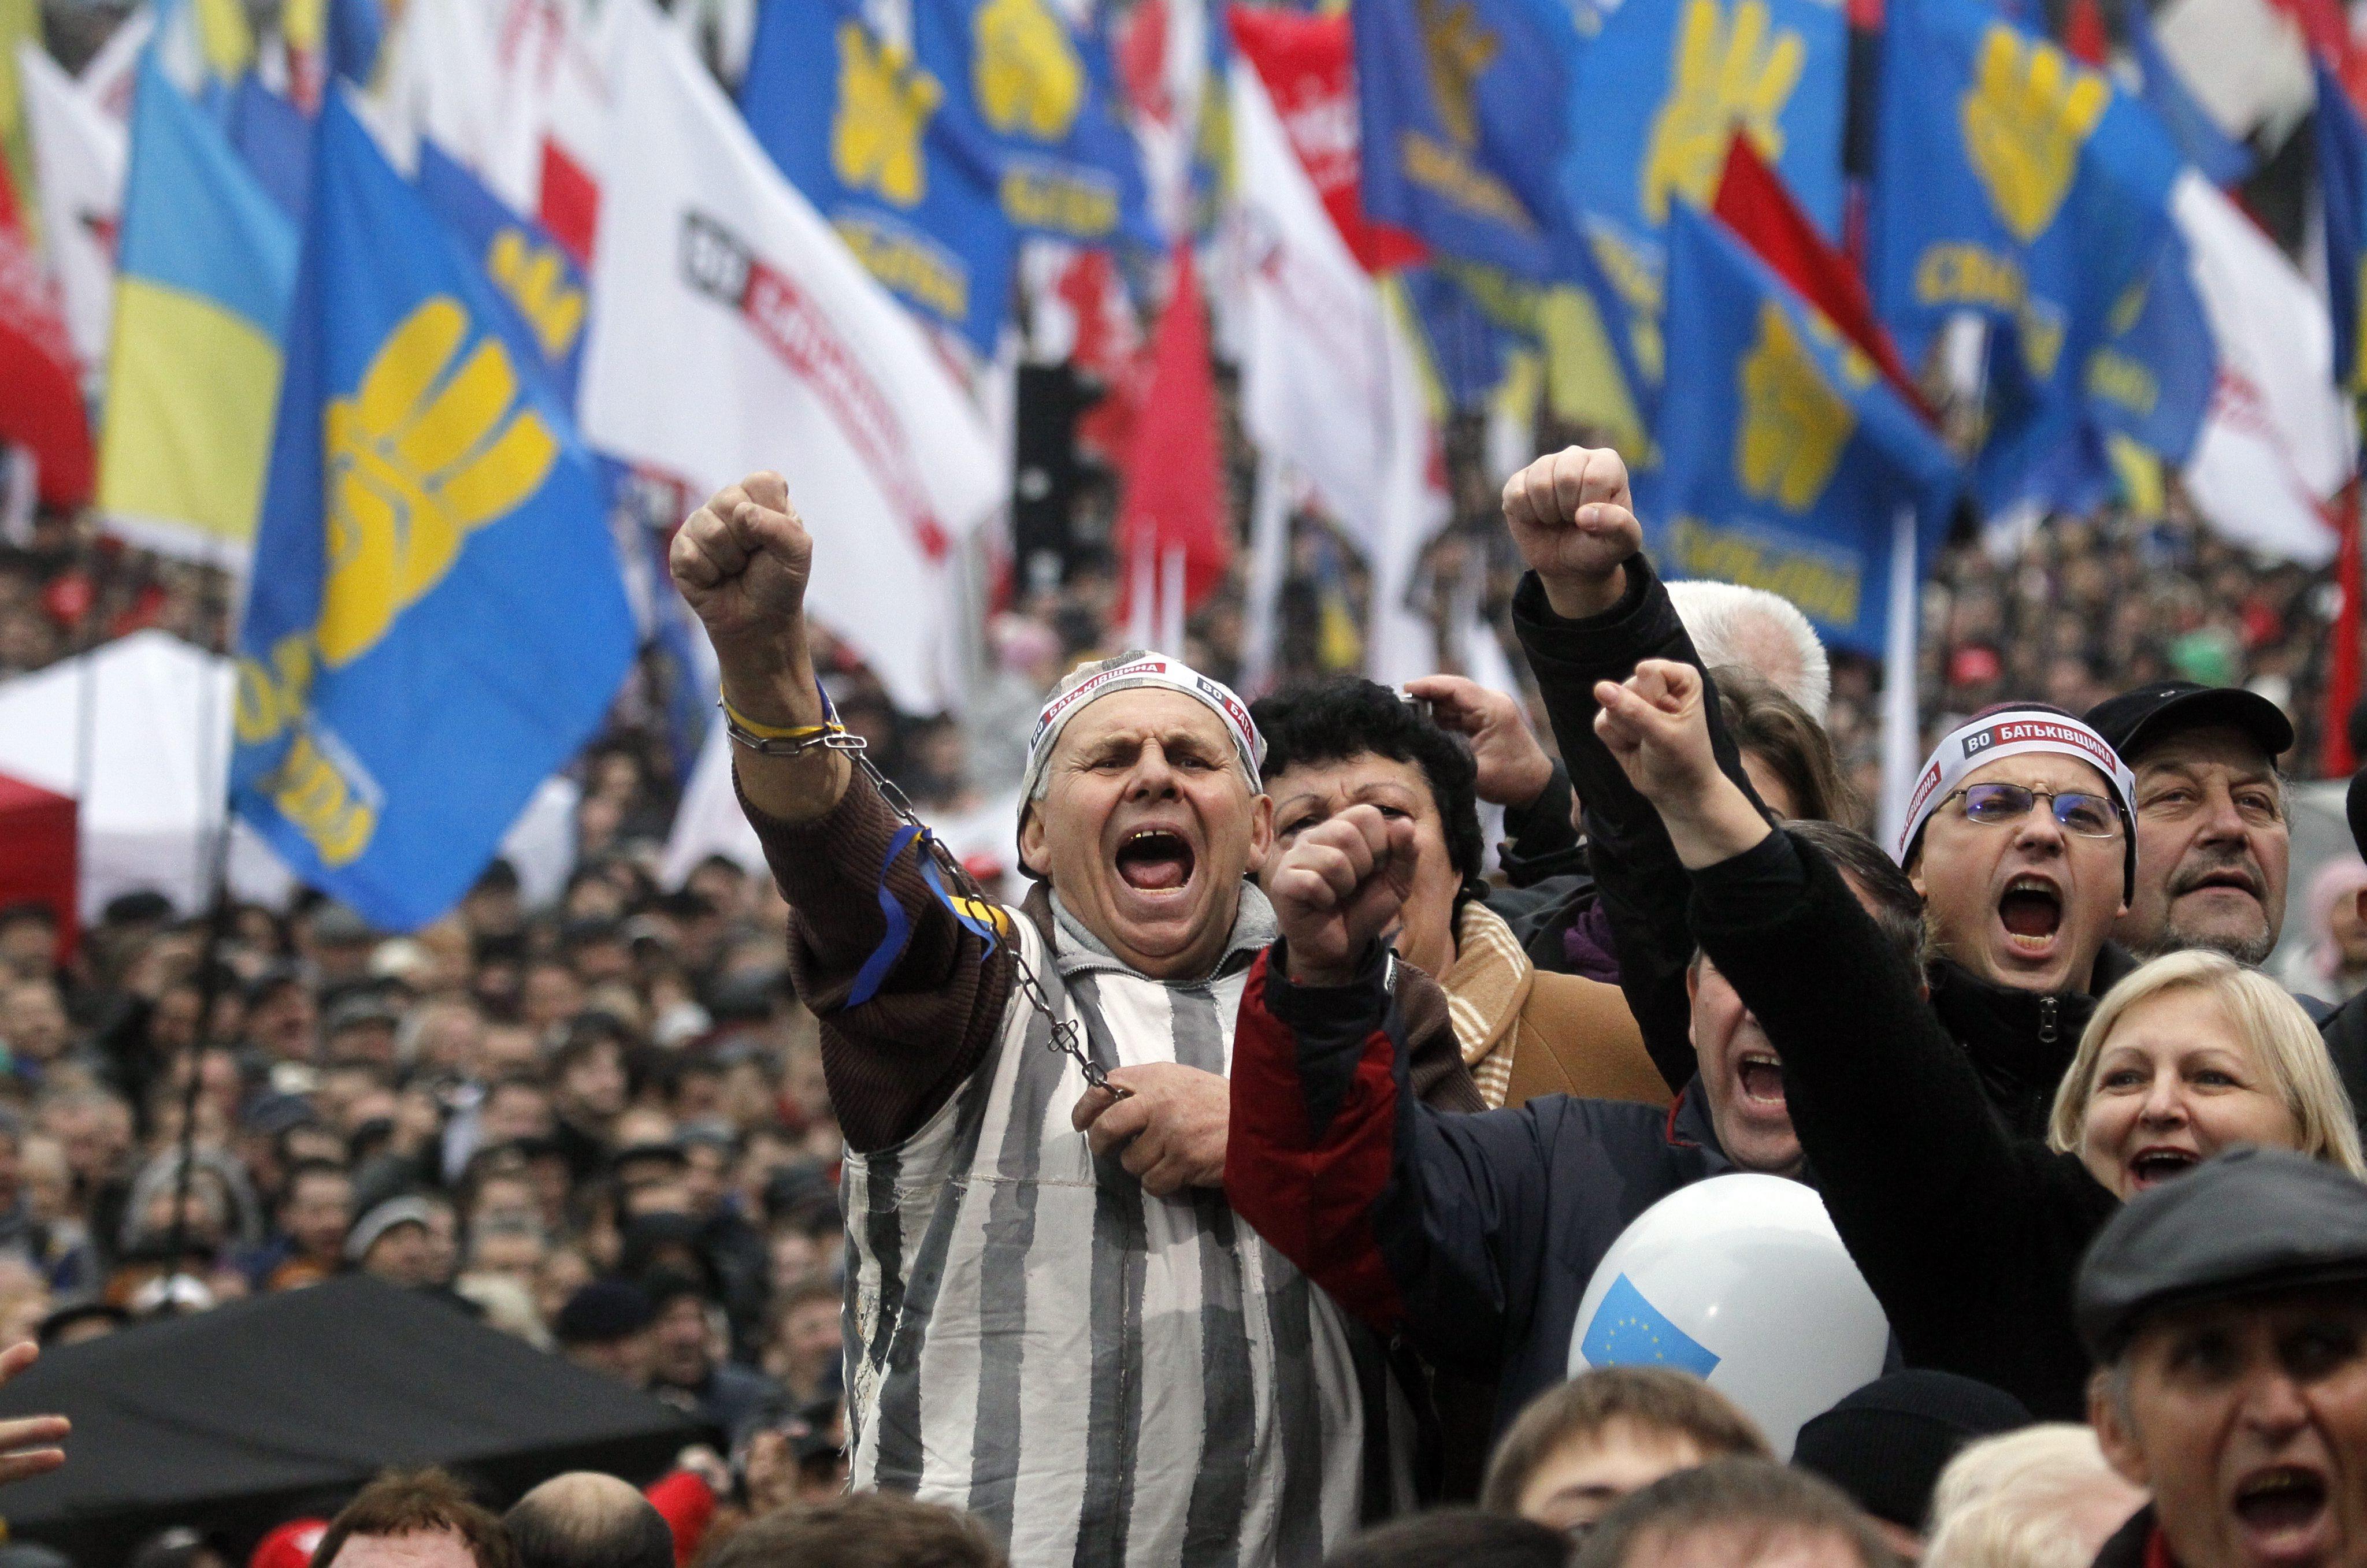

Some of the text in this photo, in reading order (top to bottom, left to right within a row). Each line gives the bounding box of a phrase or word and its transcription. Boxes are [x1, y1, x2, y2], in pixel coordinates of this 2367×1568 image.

[1049, 664, 1158, 718] БАТЬКІВЩИНА
[1202, 681, 1222, 700] ВО
[1968, 724, 2113, 768] ВО БАТЬКІВЩИНА
